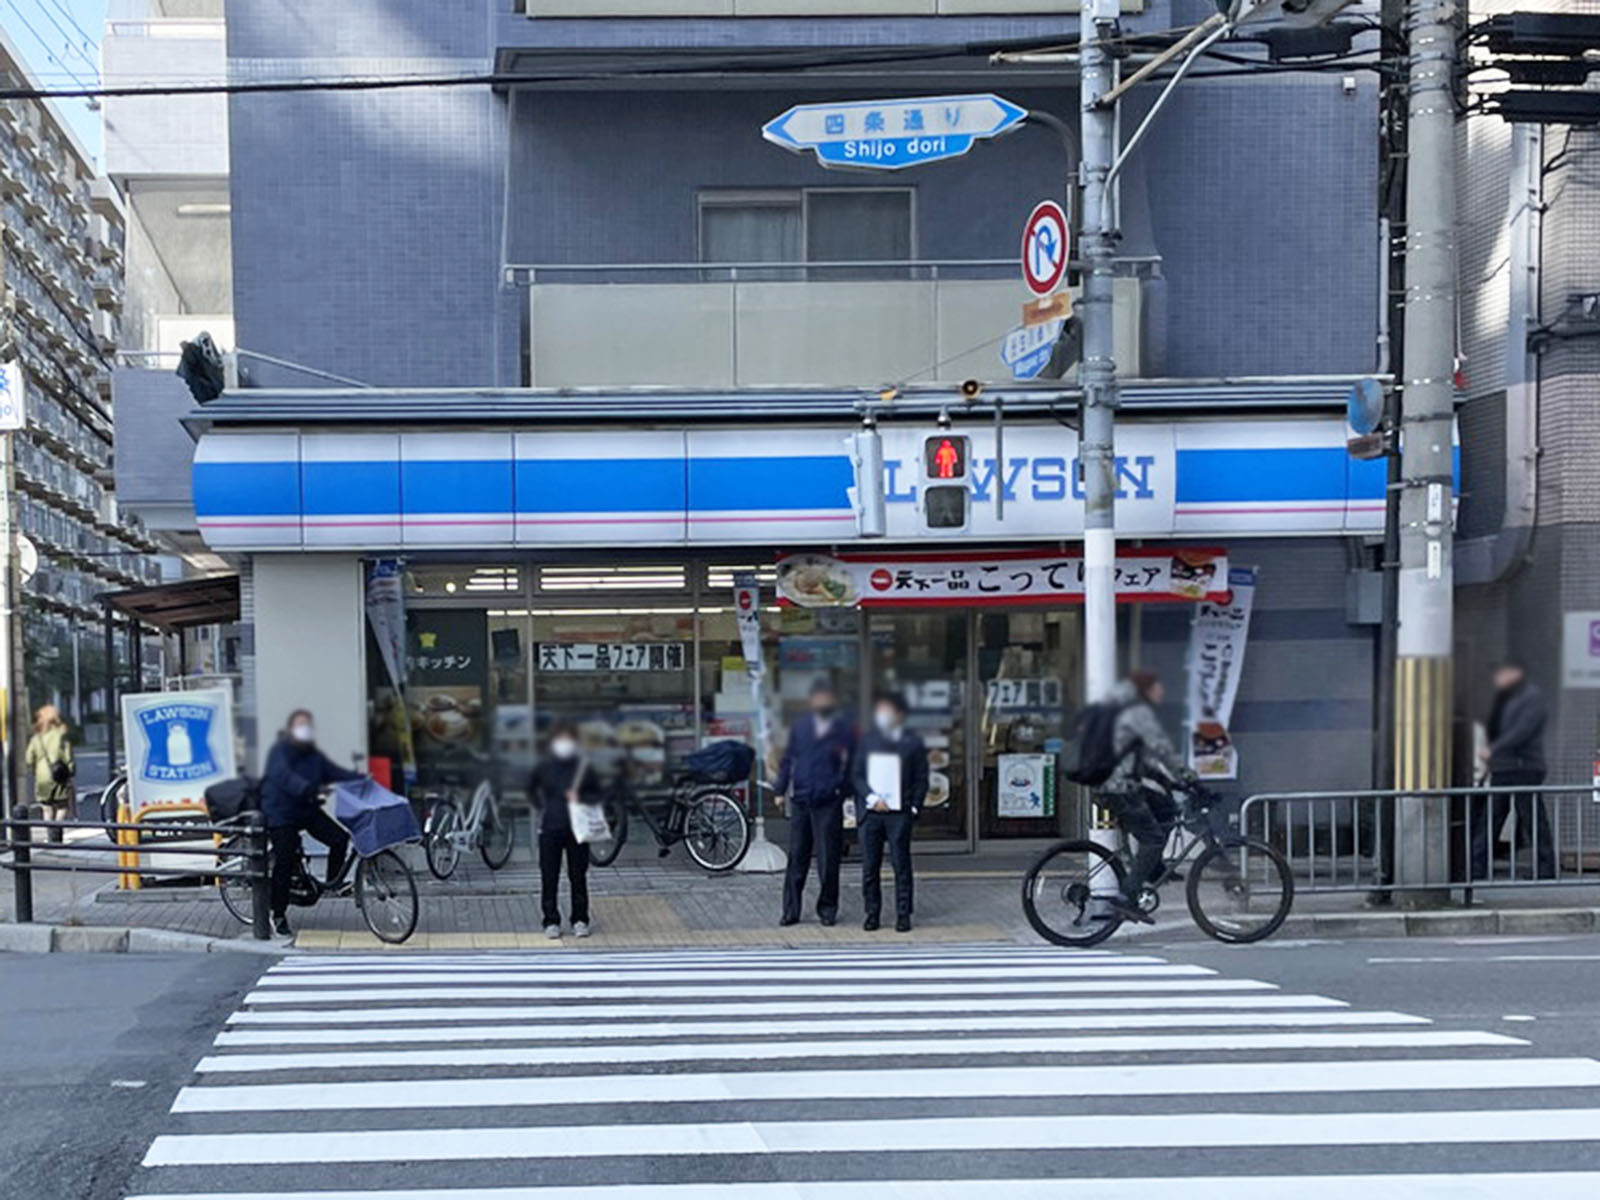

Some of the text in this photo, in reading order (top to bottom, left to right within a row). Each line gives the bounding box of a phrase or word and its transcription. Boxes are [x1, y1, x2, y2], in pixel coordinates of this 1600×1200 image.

[824, 107, 961, 135] 四条通り
[844, 138, 946, 160] Shijo dori
[883, 456, 1155, 503] LWSN
[143, 705, 210, 725] LAWSON
[149, 761, 213, 779] STATION
